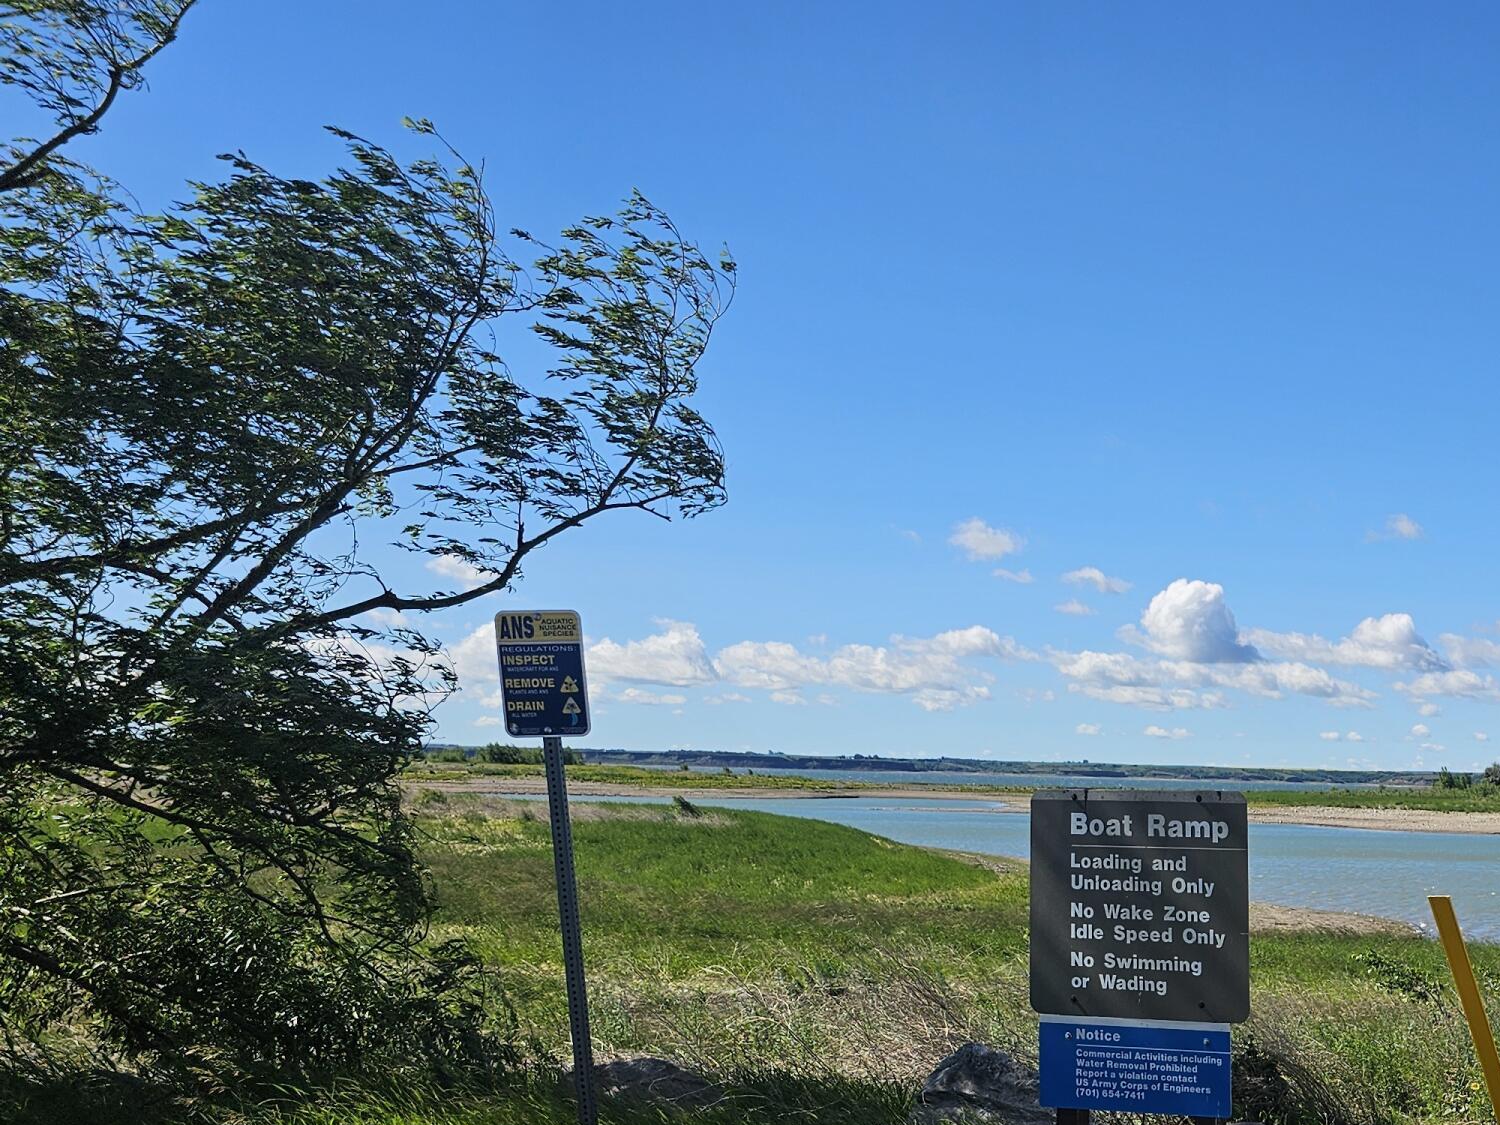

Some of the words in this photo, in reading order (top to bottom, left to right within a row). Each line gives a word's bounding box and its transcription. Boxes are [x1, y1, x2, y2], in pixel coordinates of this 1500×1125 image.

[500, 616, 534, 639] ANS
[503, 655, 555, 665] INSPECT
[505, 678, 555, 688] REMOVE
[507, 701, 544, 711] DRAIN
[1070, 812, 1133, 837] Boat
[1148, 814, 1229, 843] Ramp
[1070, 853, 1142, 873] Loading
[1152, 855, 1187, 872] and
[1071, 874, 1162, 896] Unloading
[1172, 878, 1215, 897] Only
[1070, 902, 1094, 919] No
[1104, 904, 1154, 921] Wake
[1163, 906, 1211, 923] Zone
[1070, 923, 1104, 940] Idle
[1113, 925, 1173, 944] Speed
[1182, 928, 1226, 948] Only
[1070, 951, 1094, 968] No
[1104, 953, 1203, 975] Swimming
[1071, 975, 1090, 989] or
[1099, 974, 1167, 995] Wading
[1076, 1028, 1121, 1042] Notice
[1076, 1049, 1131, 1060] Commercial
[1134, 1052, 1178, 1062] Activities
[1181, 1054, 1222, 1066] including
[1077, 1059, 1104, 1068] Water
[1107, 1061, 1147, 1071] Removal
[1150, 1063, 1197, 1073] Prohibited
[1076, 1069, 1108, 1079] Report
[1119, 1071, 1158, 1081] violation
[1161, 1074, 1197, 1083] contact
[1076, 1088, 1099, 1099] (701)
[1102, 1090, 1145, 1100] 654-7411
[1092, 1080, 1117, 1089] Army
[1121, 1082, 1148, 1091] Corps
[1163, 1084, 1211, 1094] Engineers
